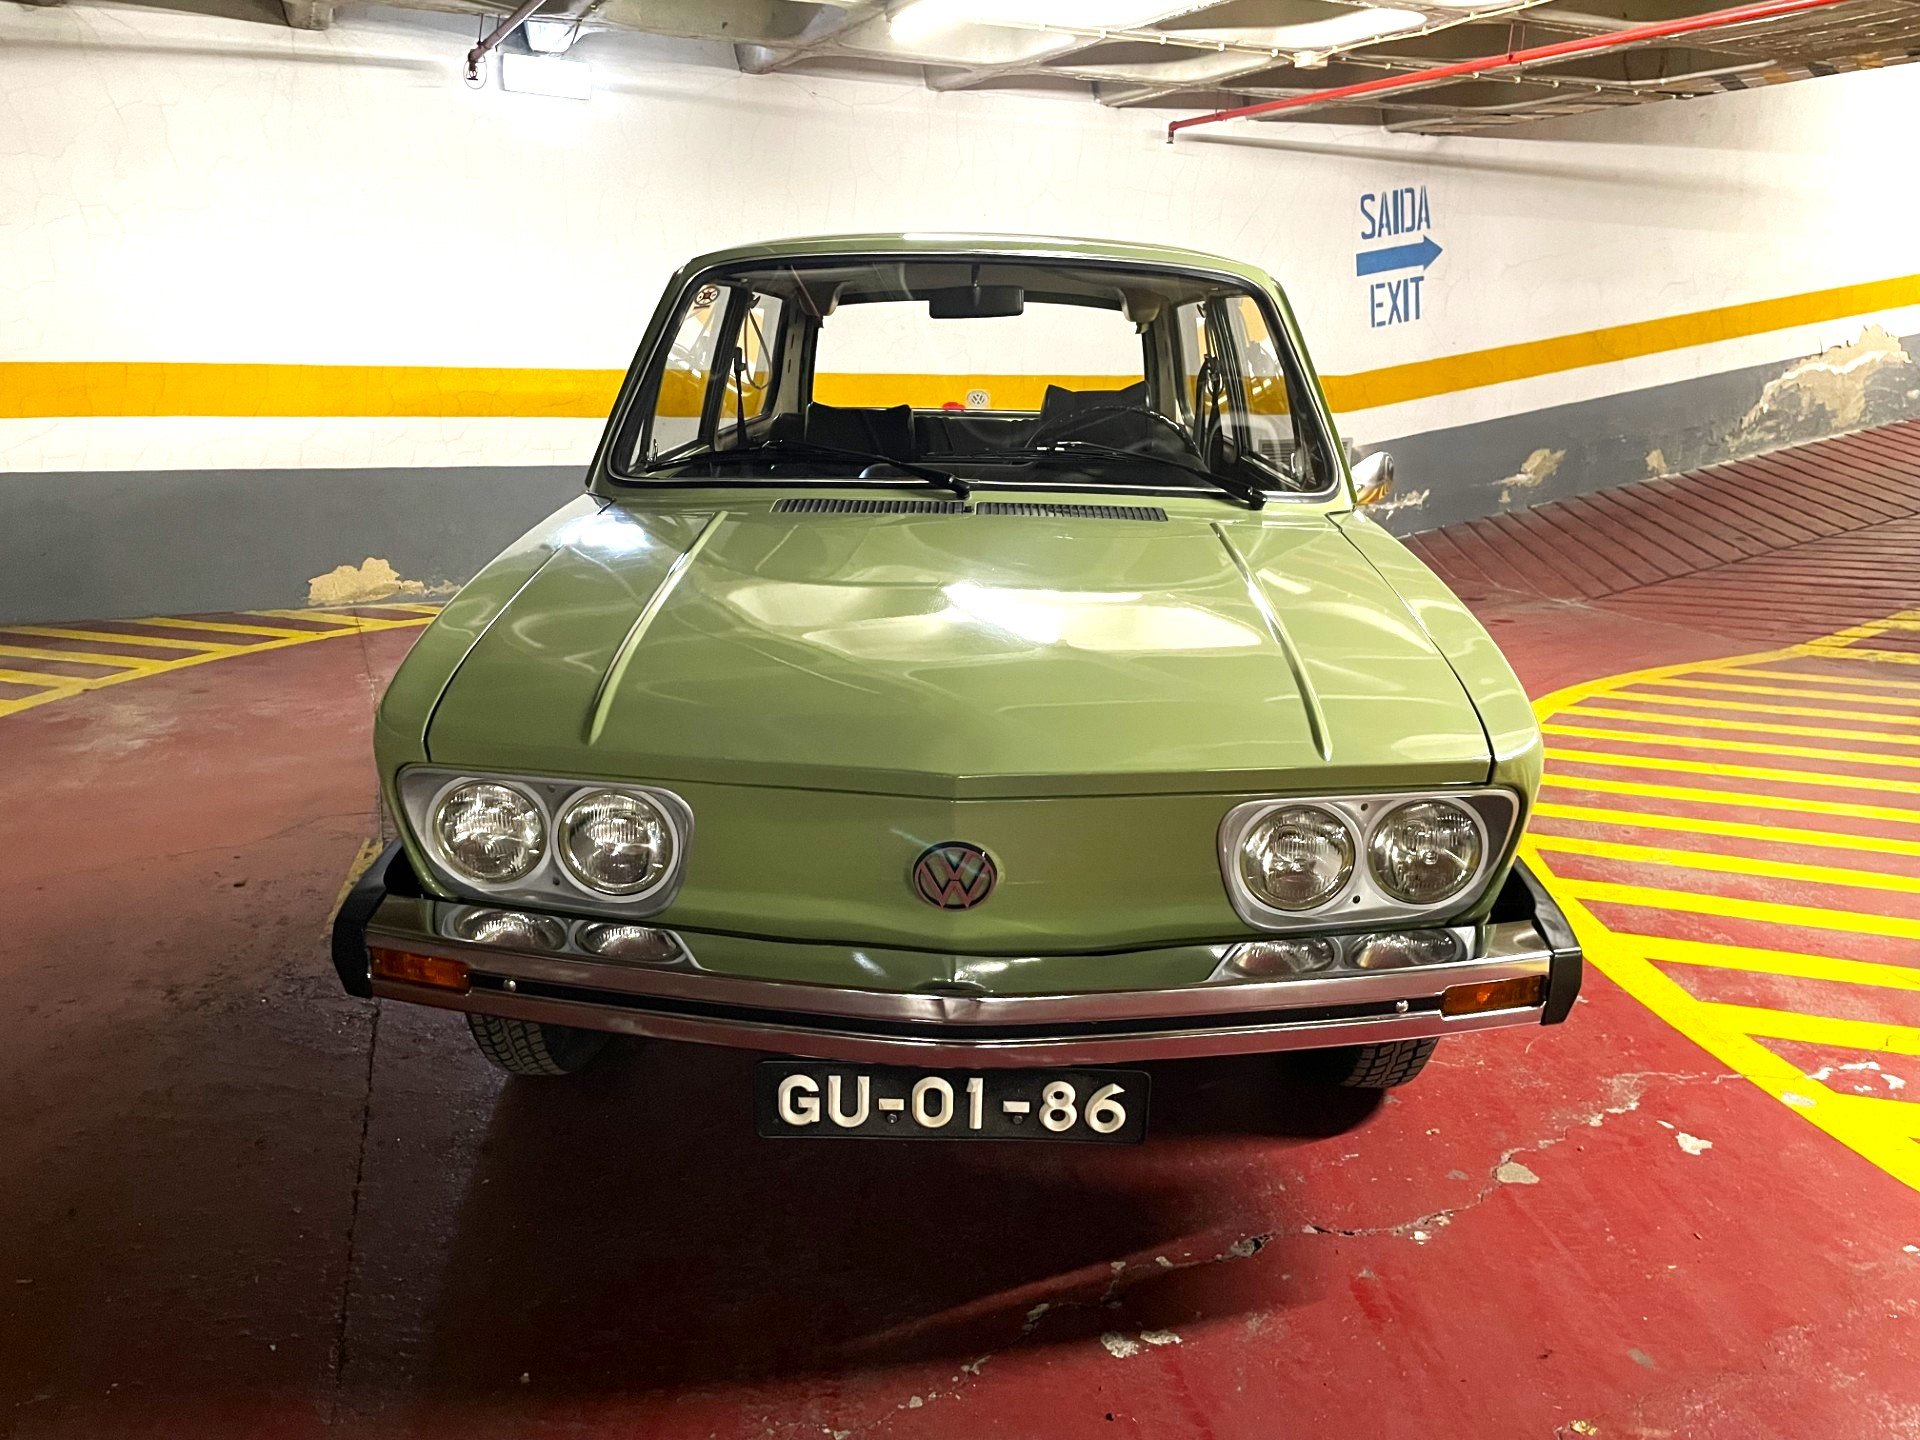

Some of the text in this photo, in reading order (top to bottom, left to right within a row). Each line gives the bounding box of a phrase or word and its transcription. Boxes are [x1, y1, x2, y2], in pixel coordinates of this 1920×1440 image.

[1360, 185, 1431, 240] SAIDA
[1370, 276, 1425, 328] EXIT
[969, 392, 987, 406] VW
[916, 846, 994, 909] VW
[777, 1073, 1126, 1134] GU-01-86
